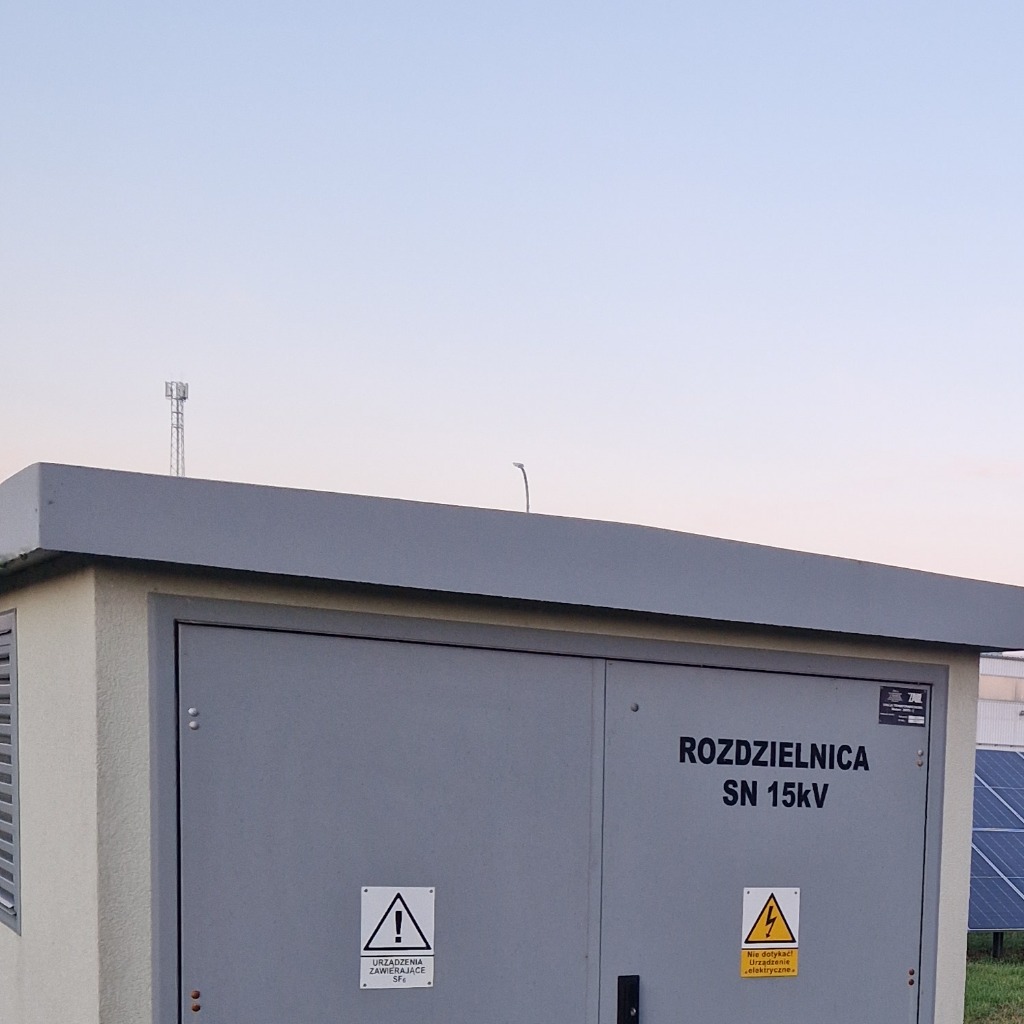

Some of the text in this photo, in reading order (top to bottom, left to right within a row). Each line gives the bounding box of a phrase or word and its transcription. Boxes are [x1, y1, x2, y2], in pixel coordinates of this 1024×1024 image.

[680, 736, 870, 771] ROZDZIELNICA
[722, 779, 829, 809] SN 15kV
[762, 950, 794, 958] dotykać!
[372, 958, 423, 968] URZĄDZENIA
[749, 959, 791, 967] Urządzenie
[369, 966, 426, 976] ZAWIERAJĄCE
[748, 967, 791, 975] elektryczne
